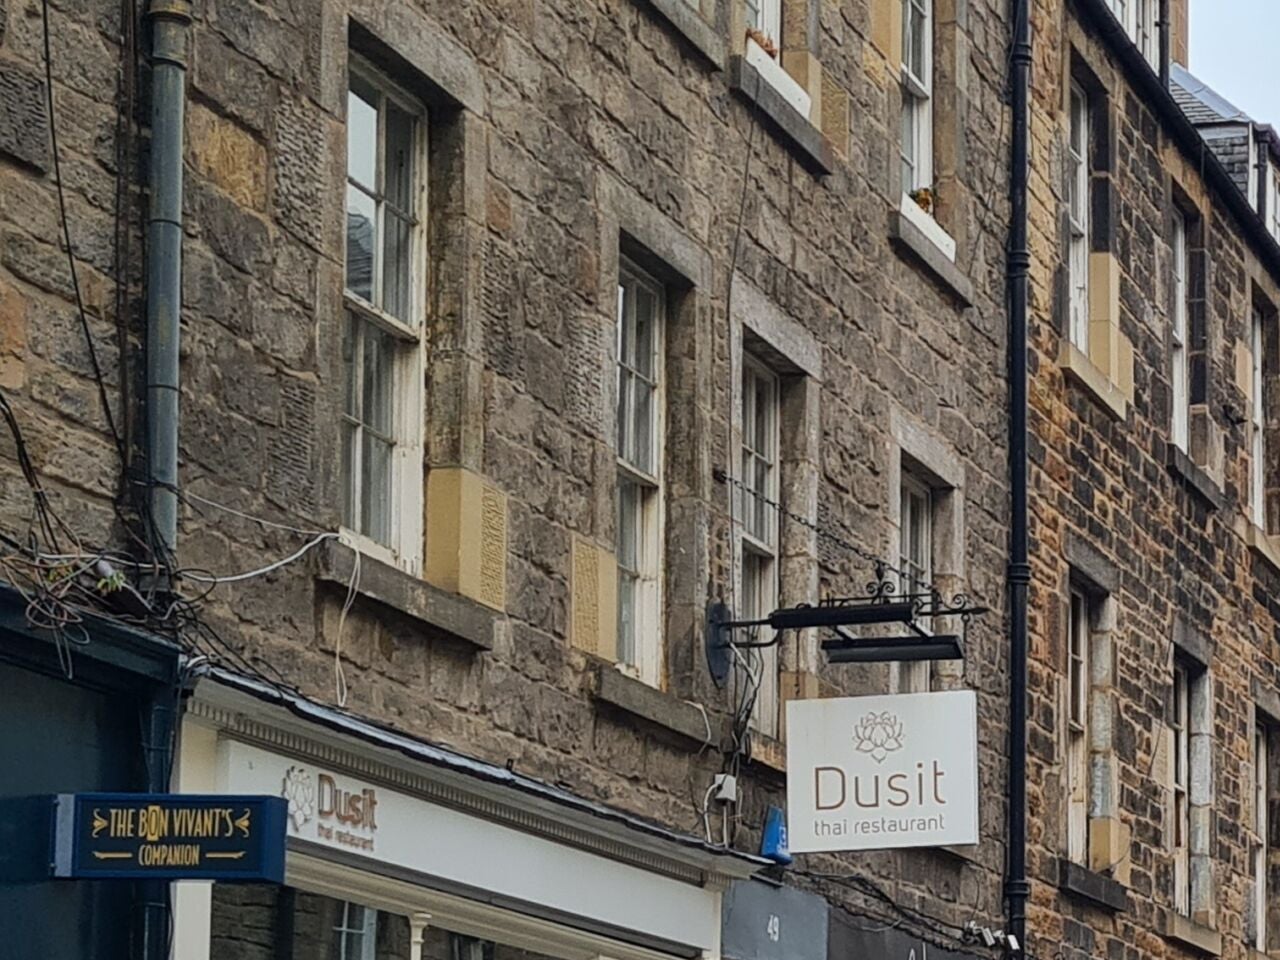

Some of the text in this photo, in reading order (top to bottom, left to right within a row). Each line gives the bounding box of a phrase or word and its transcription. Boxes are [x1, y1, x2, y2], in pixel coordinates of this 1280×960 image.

[815, 760, 946, 811] Dusit
[317, 773, 378, 832] Dusit
[109, 807, 233, 839] THE BON VIVANT'S
[814, 814, 944, 836] thai restaurant
[138, 844, 200, 867] COMPANION
[767, 915, 780, 942] 49
